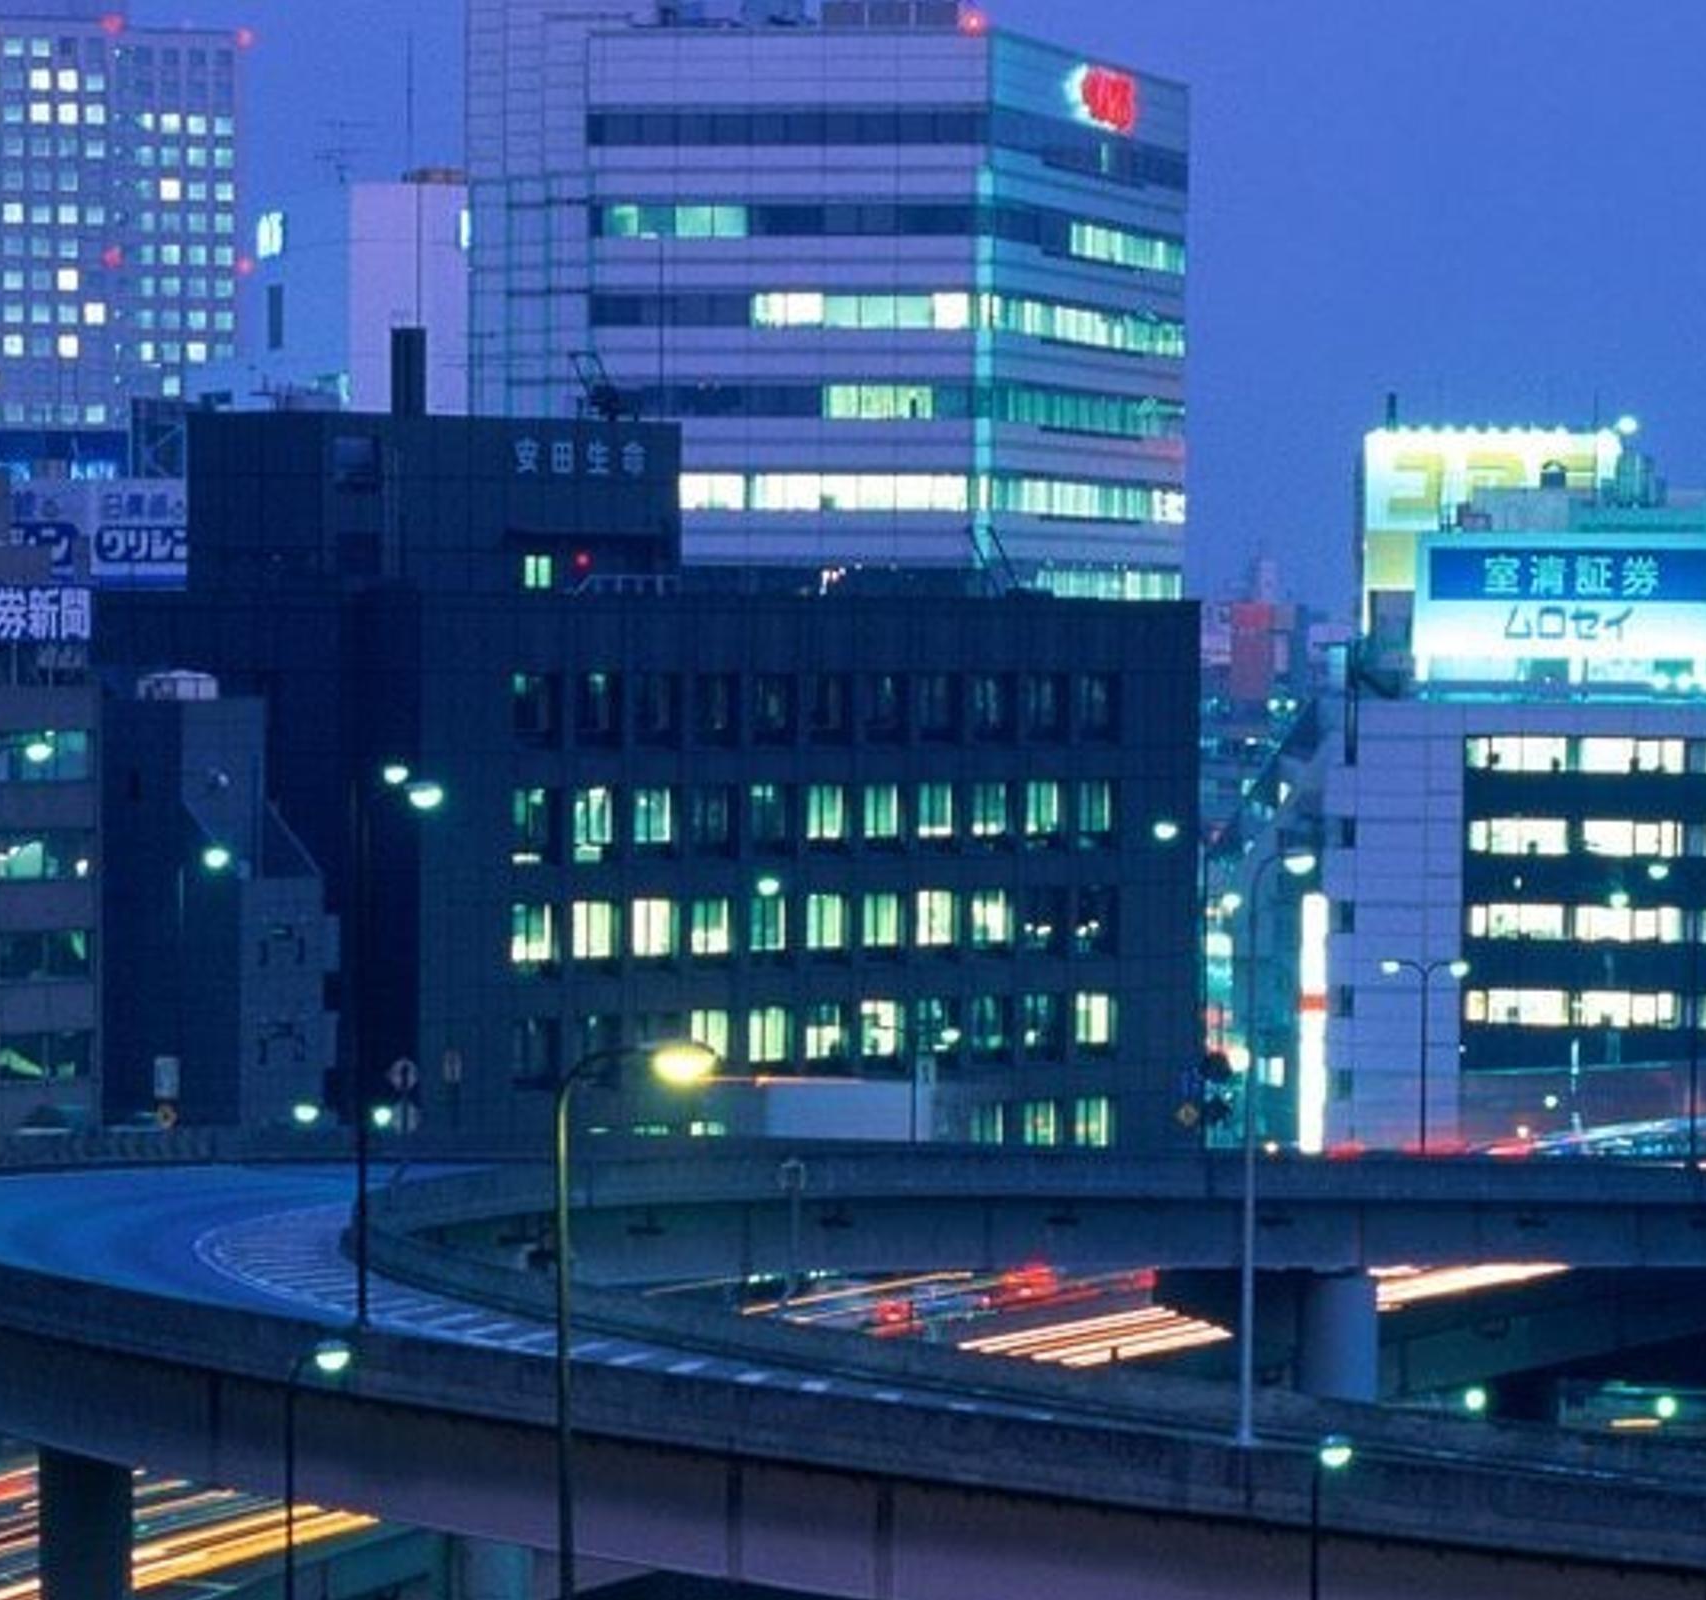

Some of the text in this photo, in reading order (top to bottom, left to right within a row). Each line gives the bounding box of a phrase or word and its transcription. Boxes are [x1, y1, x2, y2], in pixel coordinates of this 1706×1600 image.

[515, 437, 646, 476] 安田生命
[1484, 554, 1660, 597] 室清証券
[1504, 605, 1634, 640] ムロセイ
